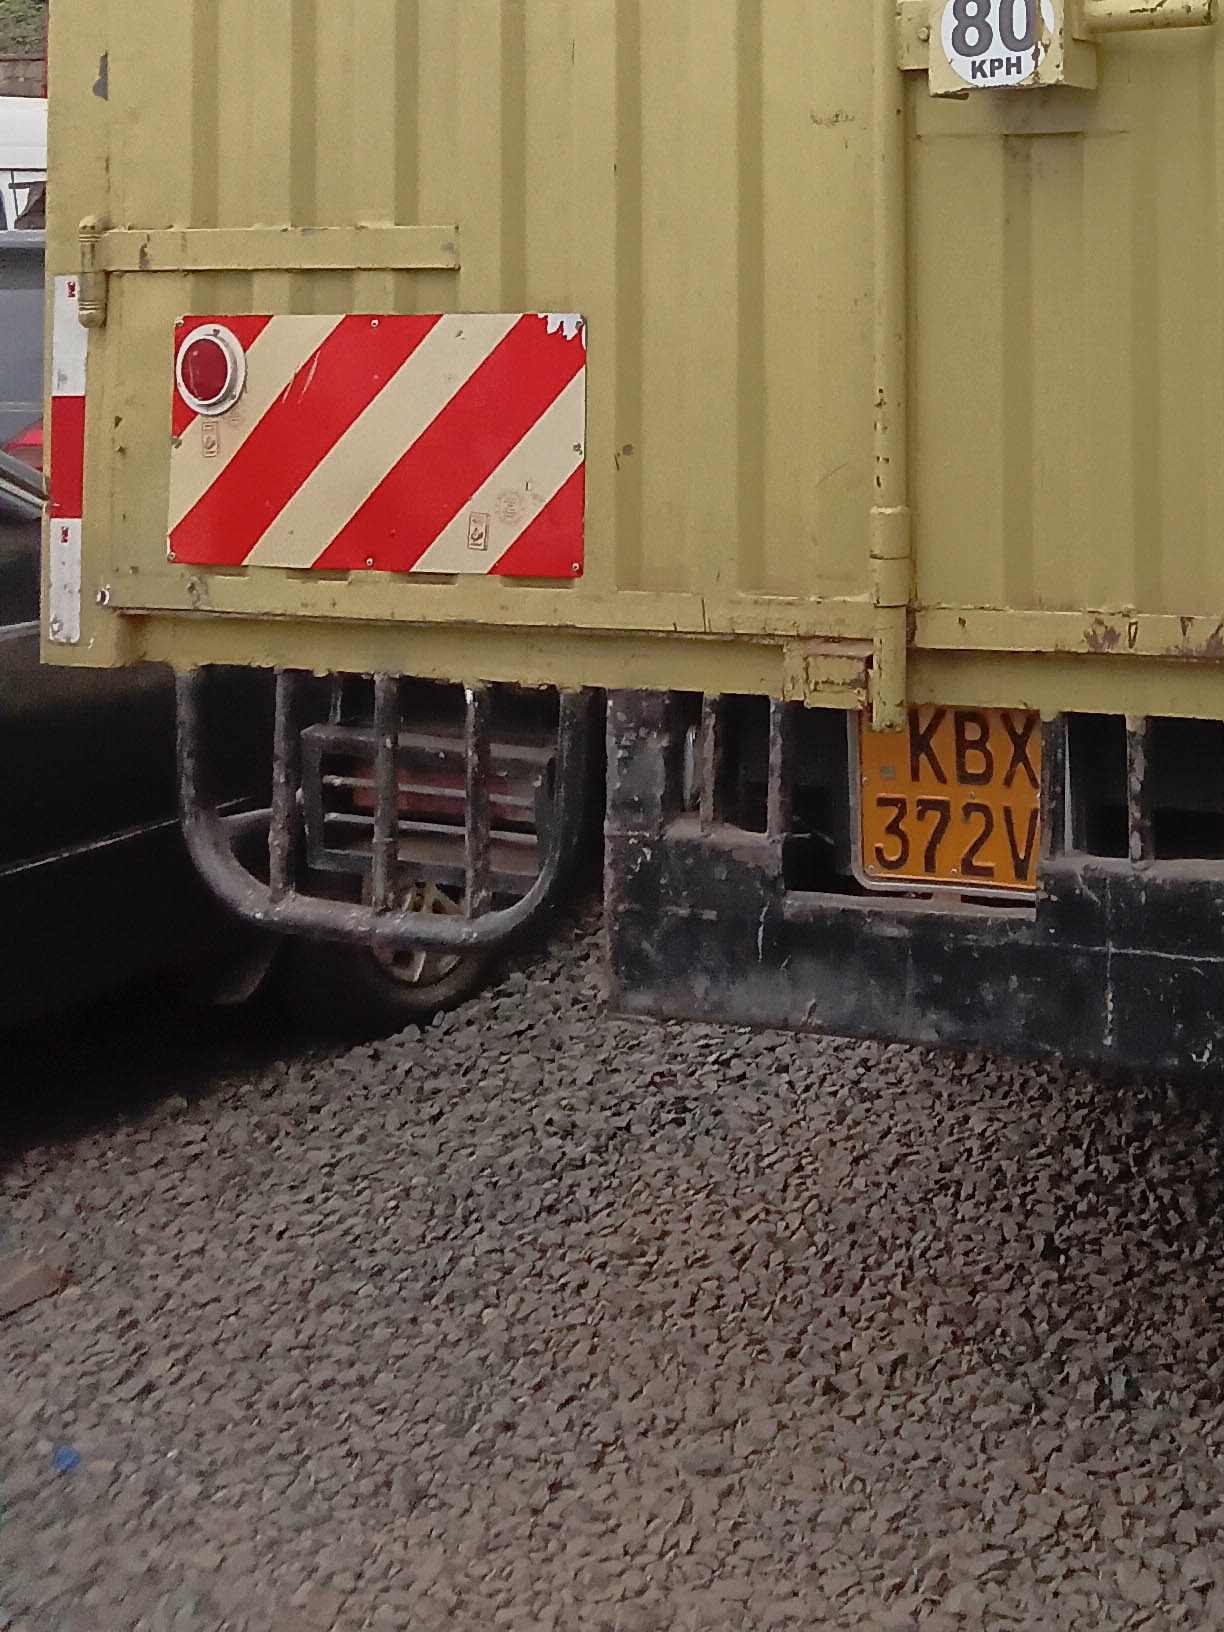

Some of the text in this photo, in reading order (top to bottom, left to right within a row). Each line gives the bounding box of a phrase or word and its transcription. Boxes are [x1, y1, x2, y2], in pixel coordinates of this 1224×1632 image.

[971, 56, 1022, 80] KPH
[908, 708, 1040, 789] KBX
[874, 796, 1040, 881] 372V
